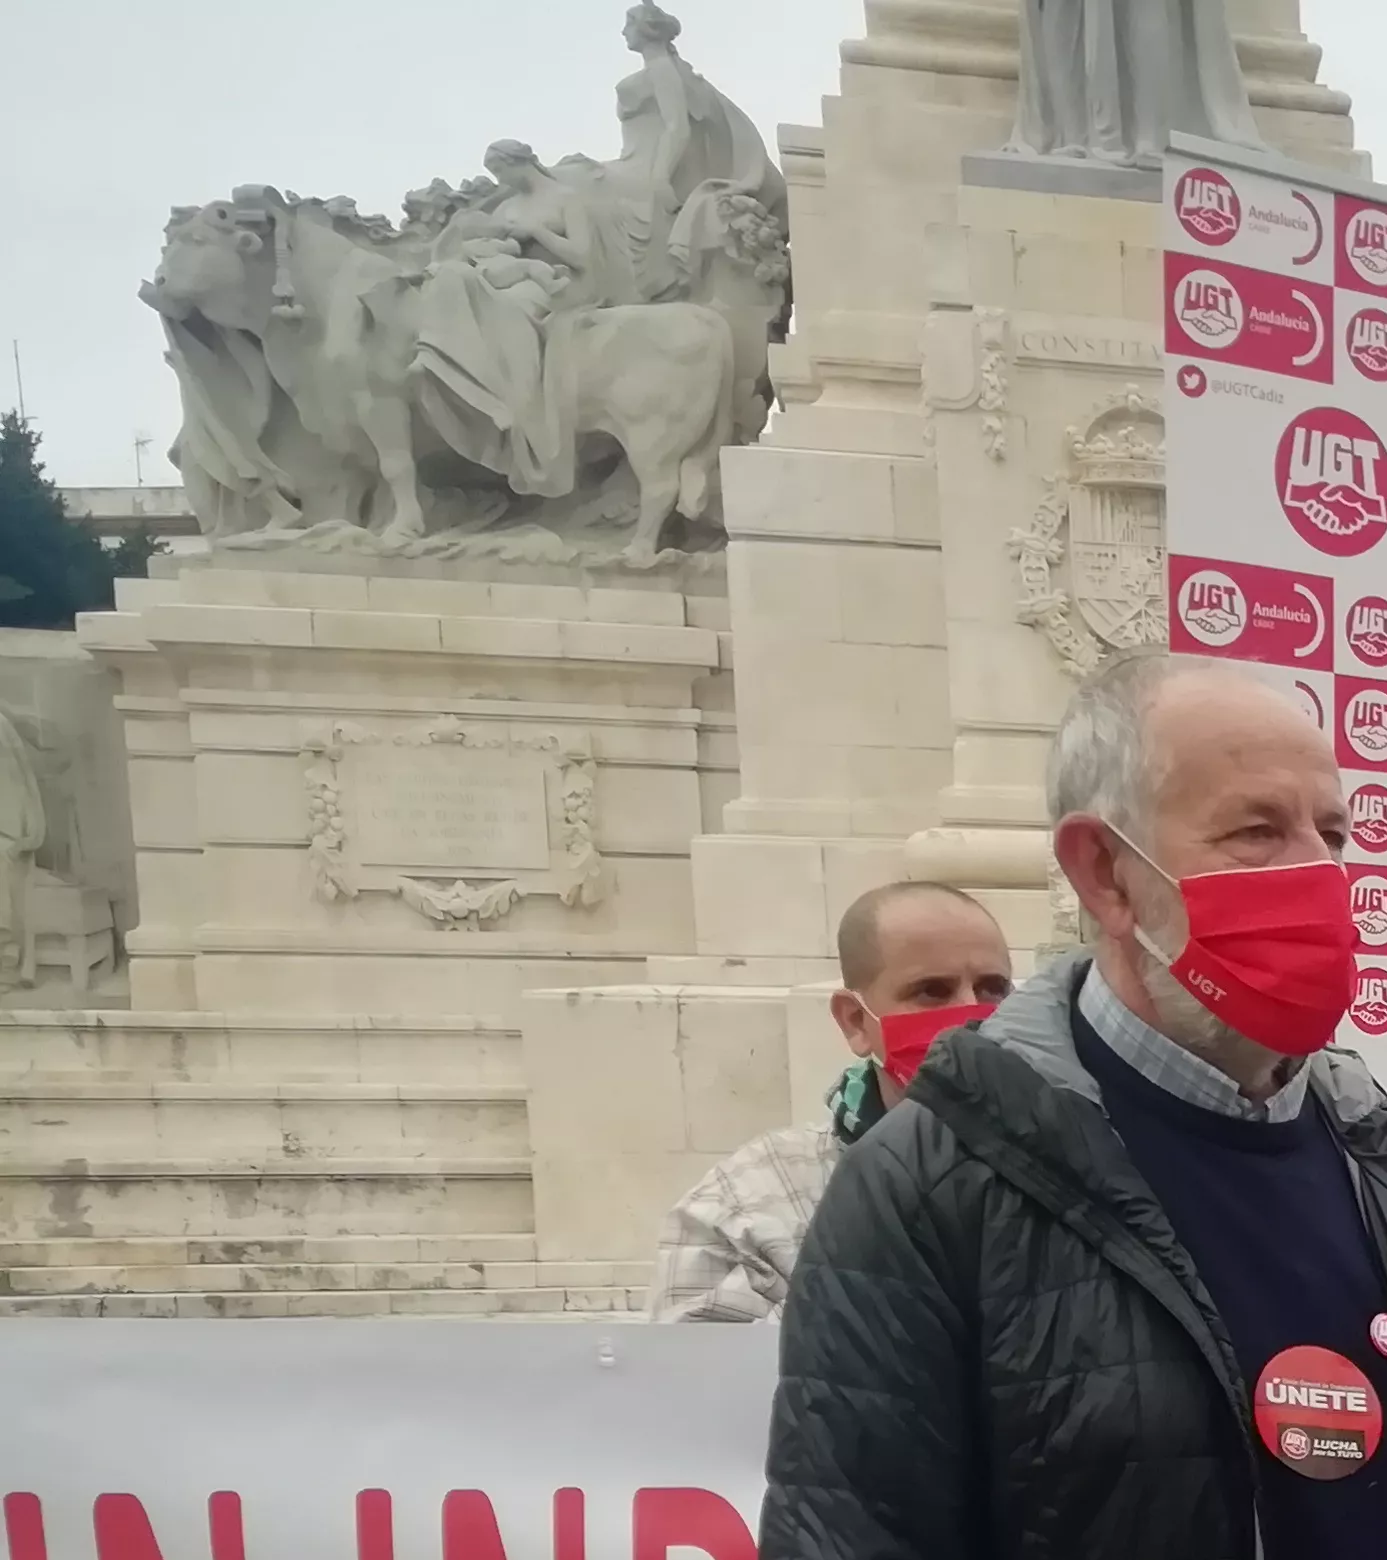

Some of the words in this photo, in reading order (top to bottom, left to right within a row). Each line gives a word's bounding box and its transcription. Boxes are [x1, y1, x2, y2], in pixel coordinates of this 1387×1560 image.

[1183, 177, 1233, 215] UGT
[1184, 280, 1233, 318] UGT
[1289, 427, 1381, 496] UGT
[1188, 582, 1237, 617] UGT
[1187, 968, 1227, 1001] UGT
[1265, 1377, 1368, 1412] ÚNETE
[1313, 1439, 1358, 1451] LUCHA
